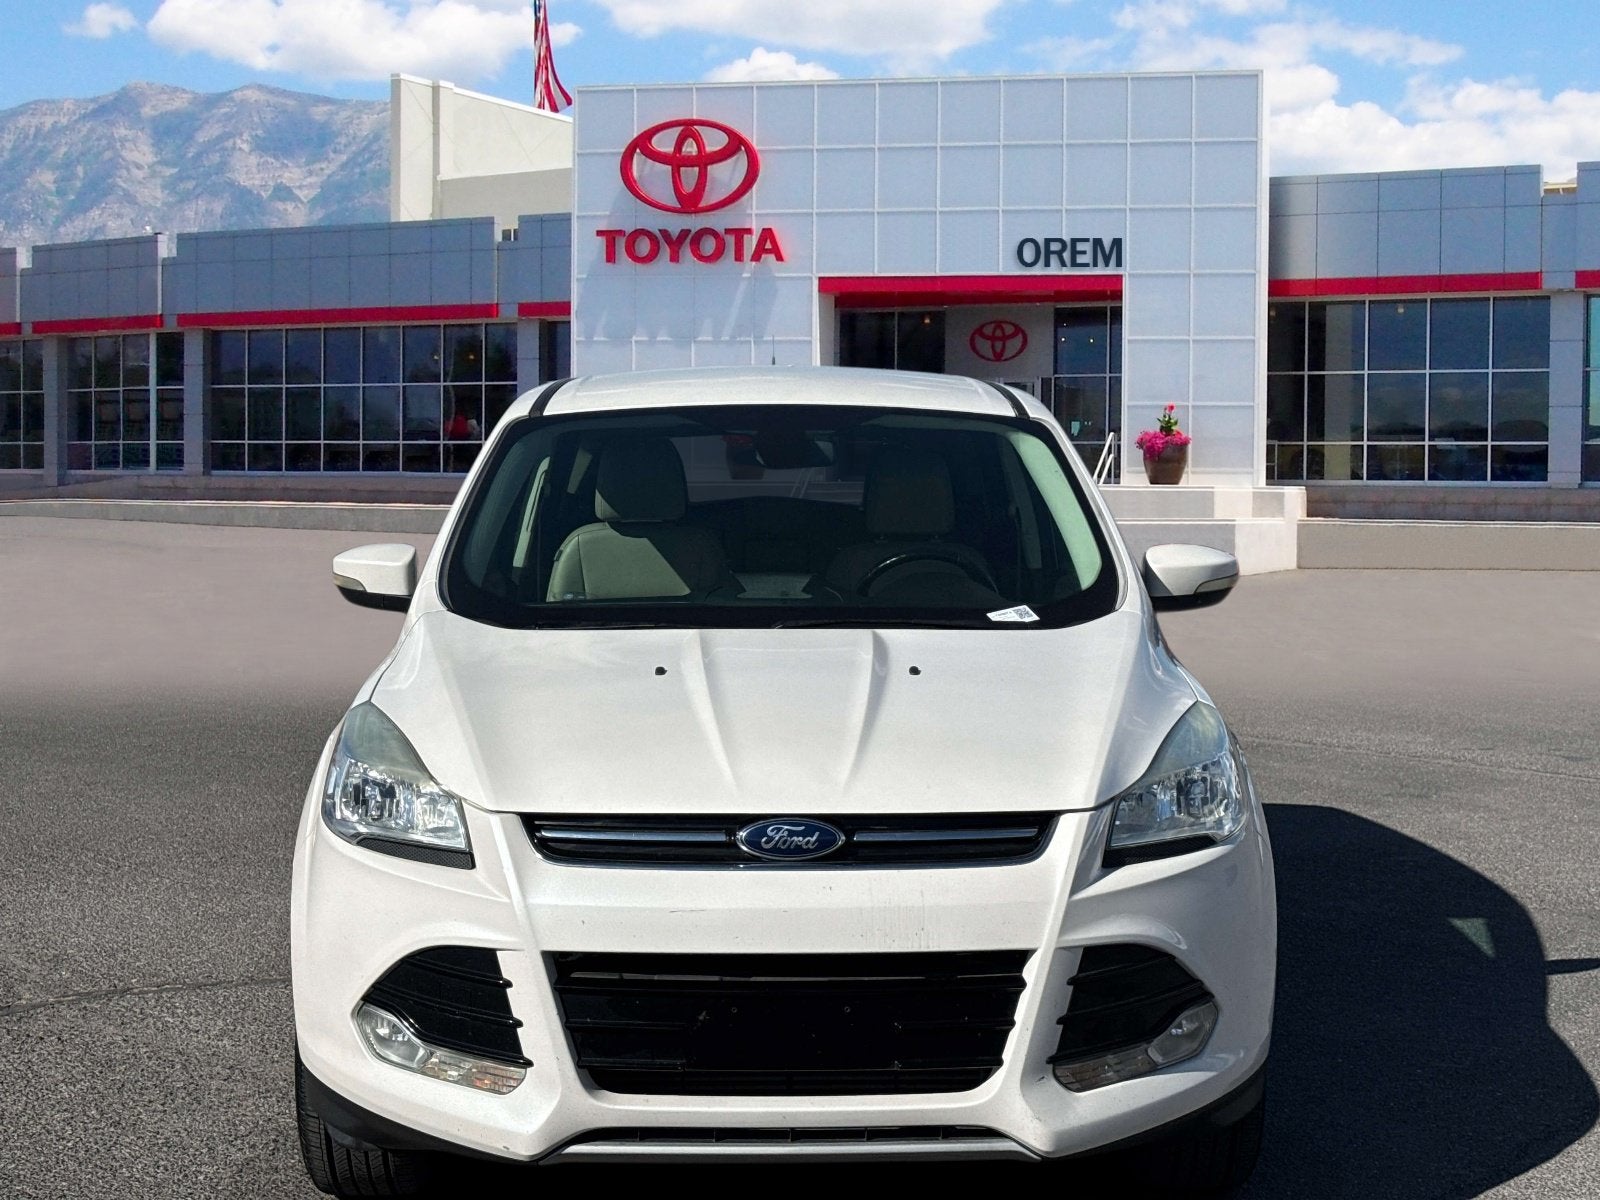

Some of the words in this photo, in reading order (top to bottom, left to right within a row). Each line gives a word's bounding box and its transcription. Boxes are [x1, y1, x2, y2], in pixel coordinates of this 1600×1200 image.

[596, 227, 785, 264] TOYOTA
[1016, 237, 1123, 268] OREM
[760, 825, 820, 849] Ford
